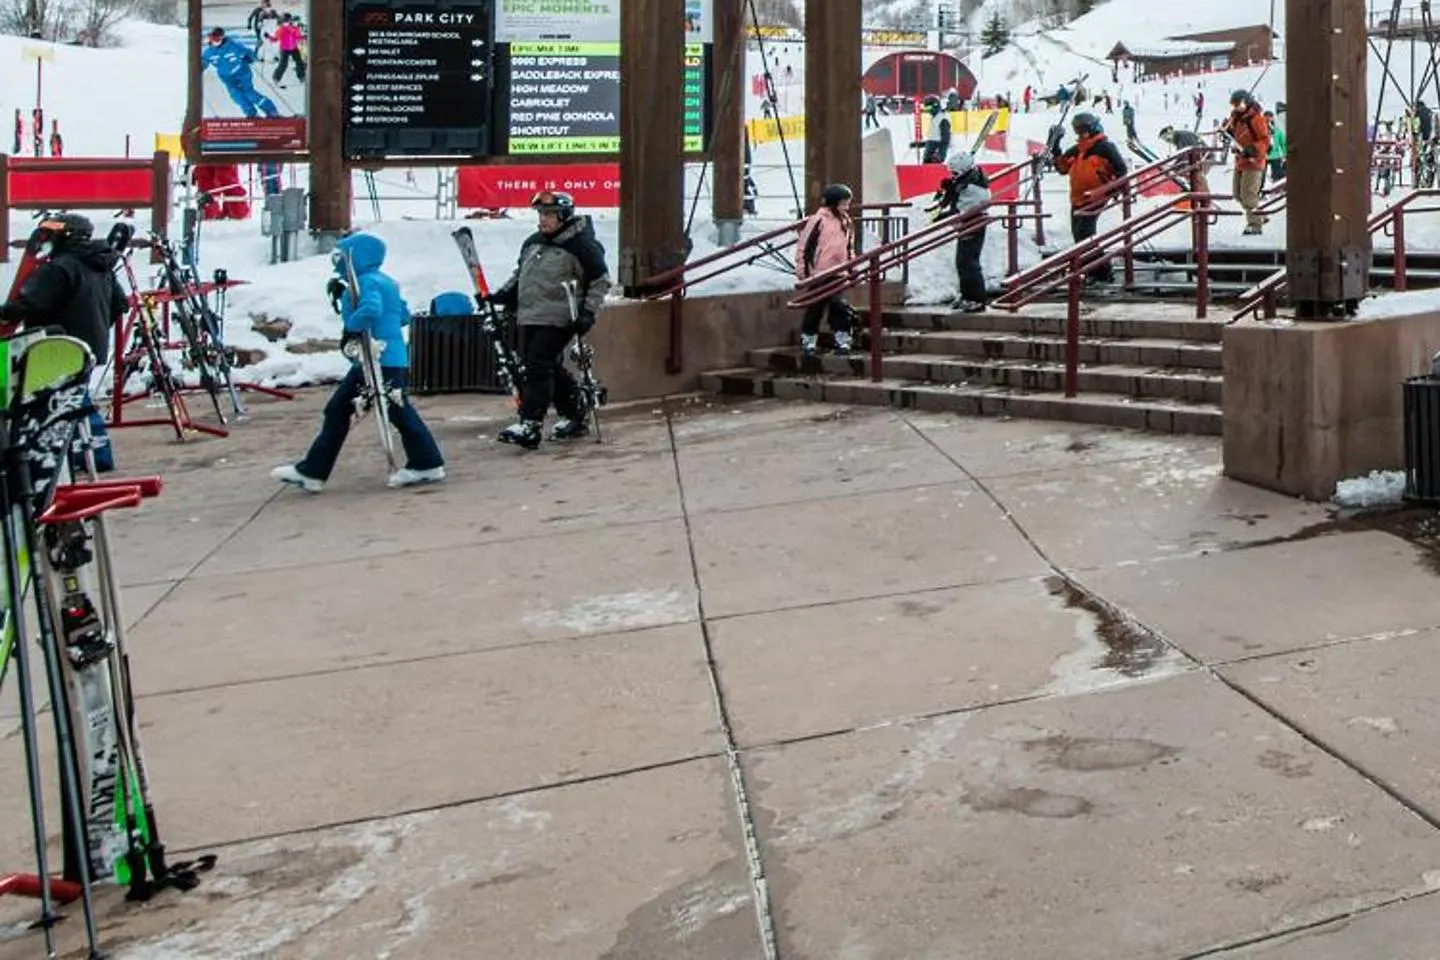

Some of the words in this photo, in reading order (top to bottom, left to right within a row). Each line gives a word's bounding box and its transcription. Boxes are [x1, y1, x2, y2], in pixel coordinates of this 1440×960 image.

[502, 4, 536, 13] EPIC
[540, 4, 610, 13] MOMENTS
[395, 13, 434, 23] PARK
[439, 13, 475, 24] CITY
[432, 31, 461, 39] SCHOOL
[511, 57, 536, 66] 9990
[537, 57, 588, 66] EXPRESS
[511, 71, 582, 80] SADDLEBACK
[583, 71, 620, 80] EXPRE
[512, 84, 538, 93] HIGH
[540, 84, 589, 93] MEADOW
[511, 98, 571, 107] CABRIOLET
[511, 113, 534, 121] RED
[536, 113, 561, 121] PINE
[562, 112, 615, 121] GONDOLA
[510, 126, 570, 135] SHORTCUT
[497, 180, 537, 189] THERE
[545, 180, 556, 189] IS
[564, 180, 596, 189] ONLY
[604, 180, 620, 189] ON
